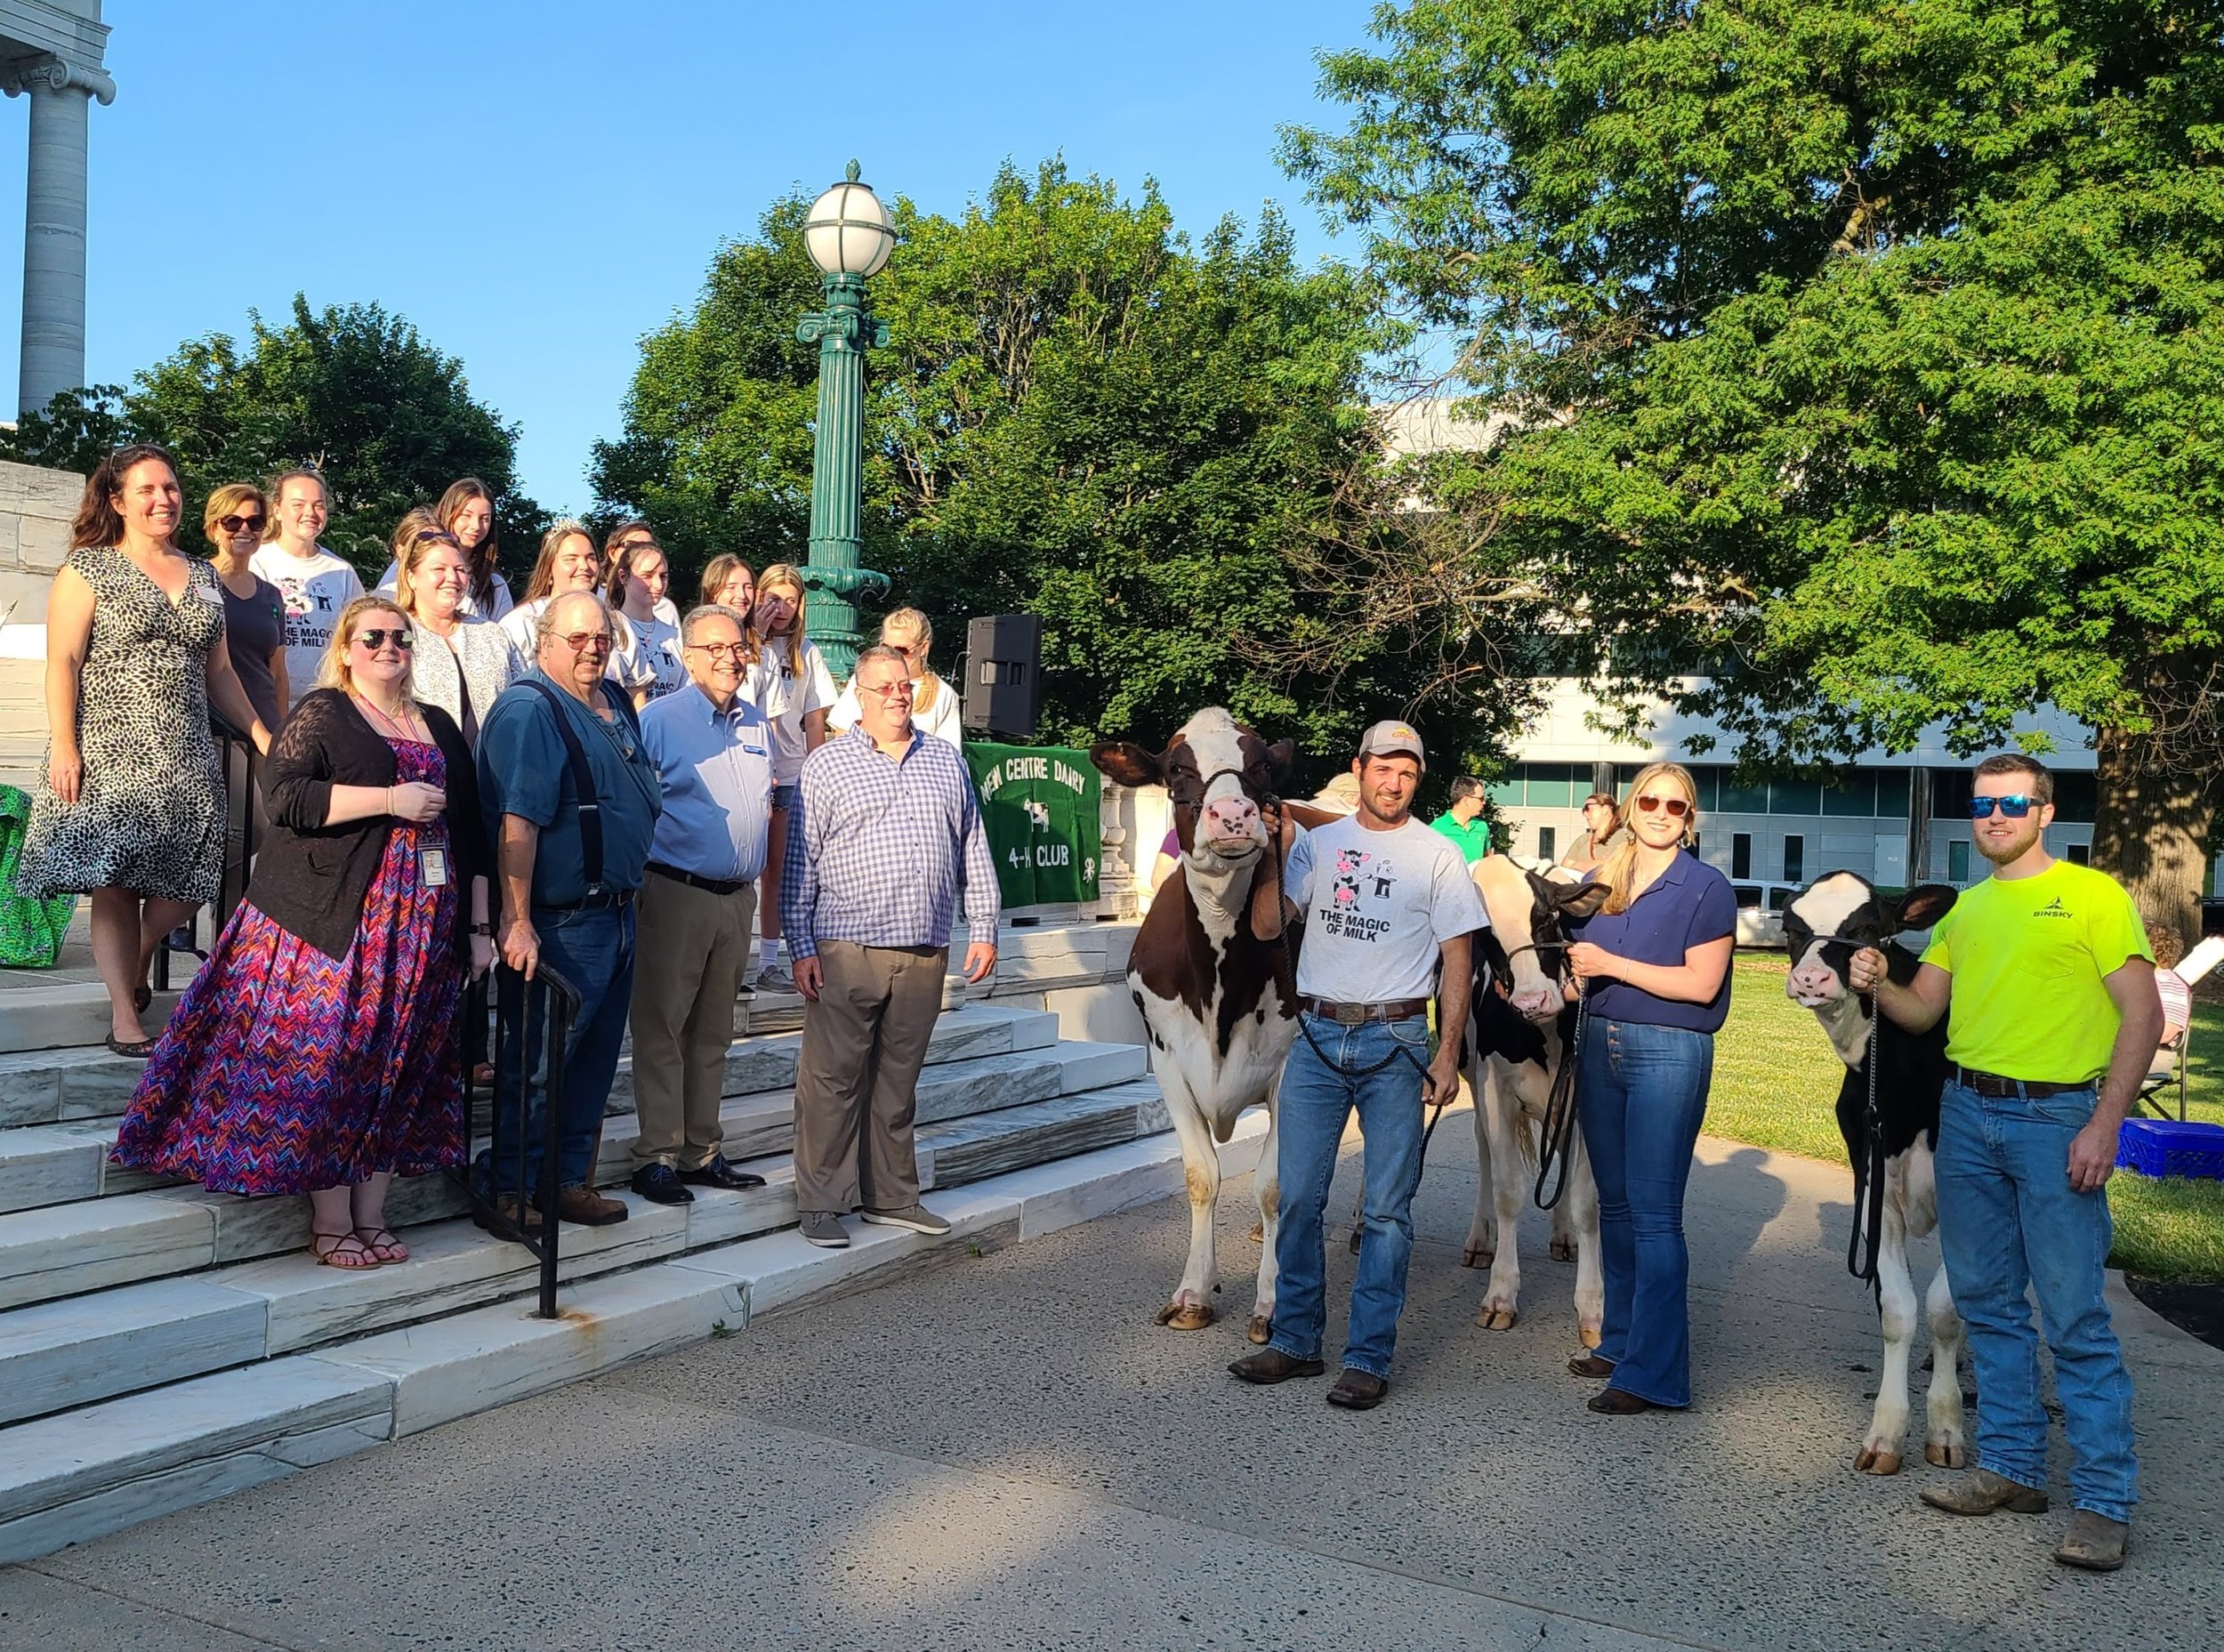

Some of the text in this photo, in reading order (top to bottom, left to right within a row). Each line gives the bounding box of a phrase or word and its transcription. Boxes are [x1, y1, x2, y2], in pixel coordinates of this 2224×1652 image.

[286, 627, 298, 637] HE
[979, 756, 1085, 805] NEW CENTRE DAIRY
[1009, 845, 1068, 869] 4-H CLUB
[1319, 909, 1390, 932] THE MAGIC
[2033, 910, 2073, 919] BINSKY
[1326, 923, 1378, 943] OF MILK
